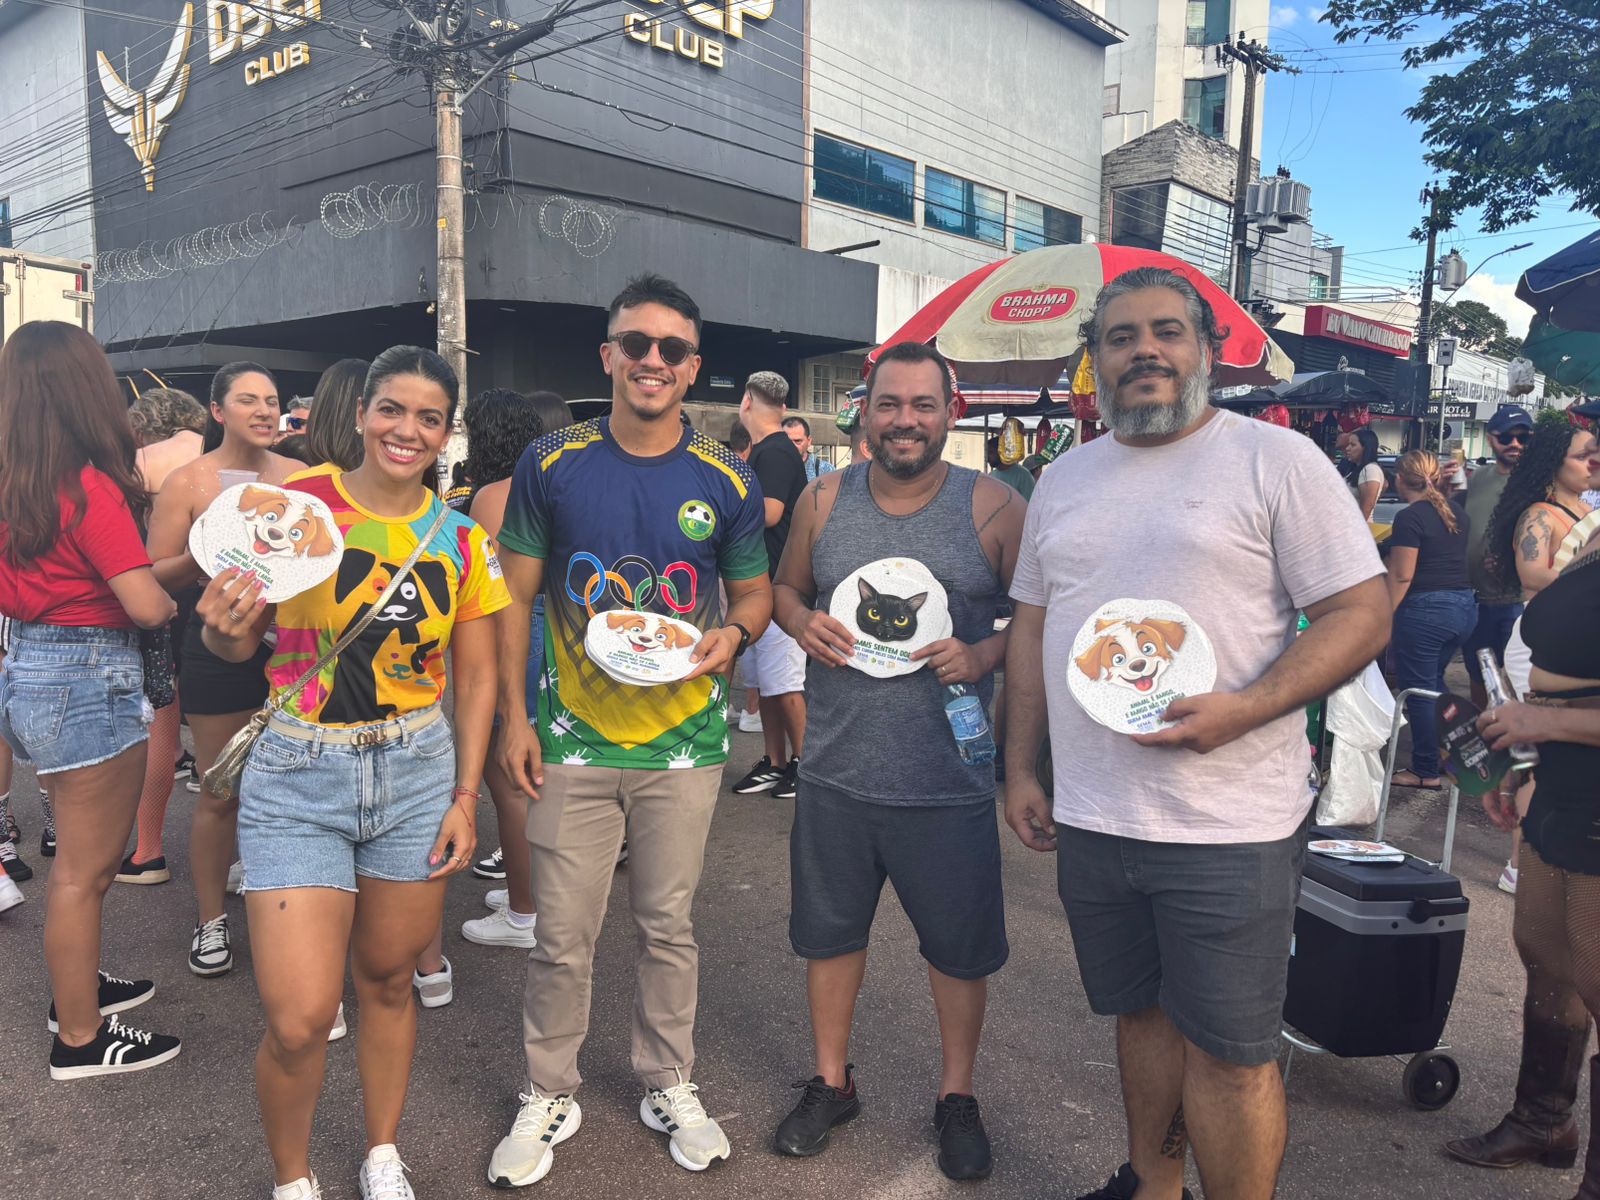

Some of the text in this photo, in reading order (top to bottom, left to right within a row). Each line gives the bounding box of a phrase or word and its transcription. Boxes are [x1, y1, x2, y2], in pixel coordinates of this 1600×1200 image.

[625, 13, 724, 69] CLUB
[245, 41, 310, 86] CLUB
[1001, 292, 1069, 308] BRAHMA
[1008, 306, 1052, 318] CHOPP
[874, 641, 899, 655] SENTEM
